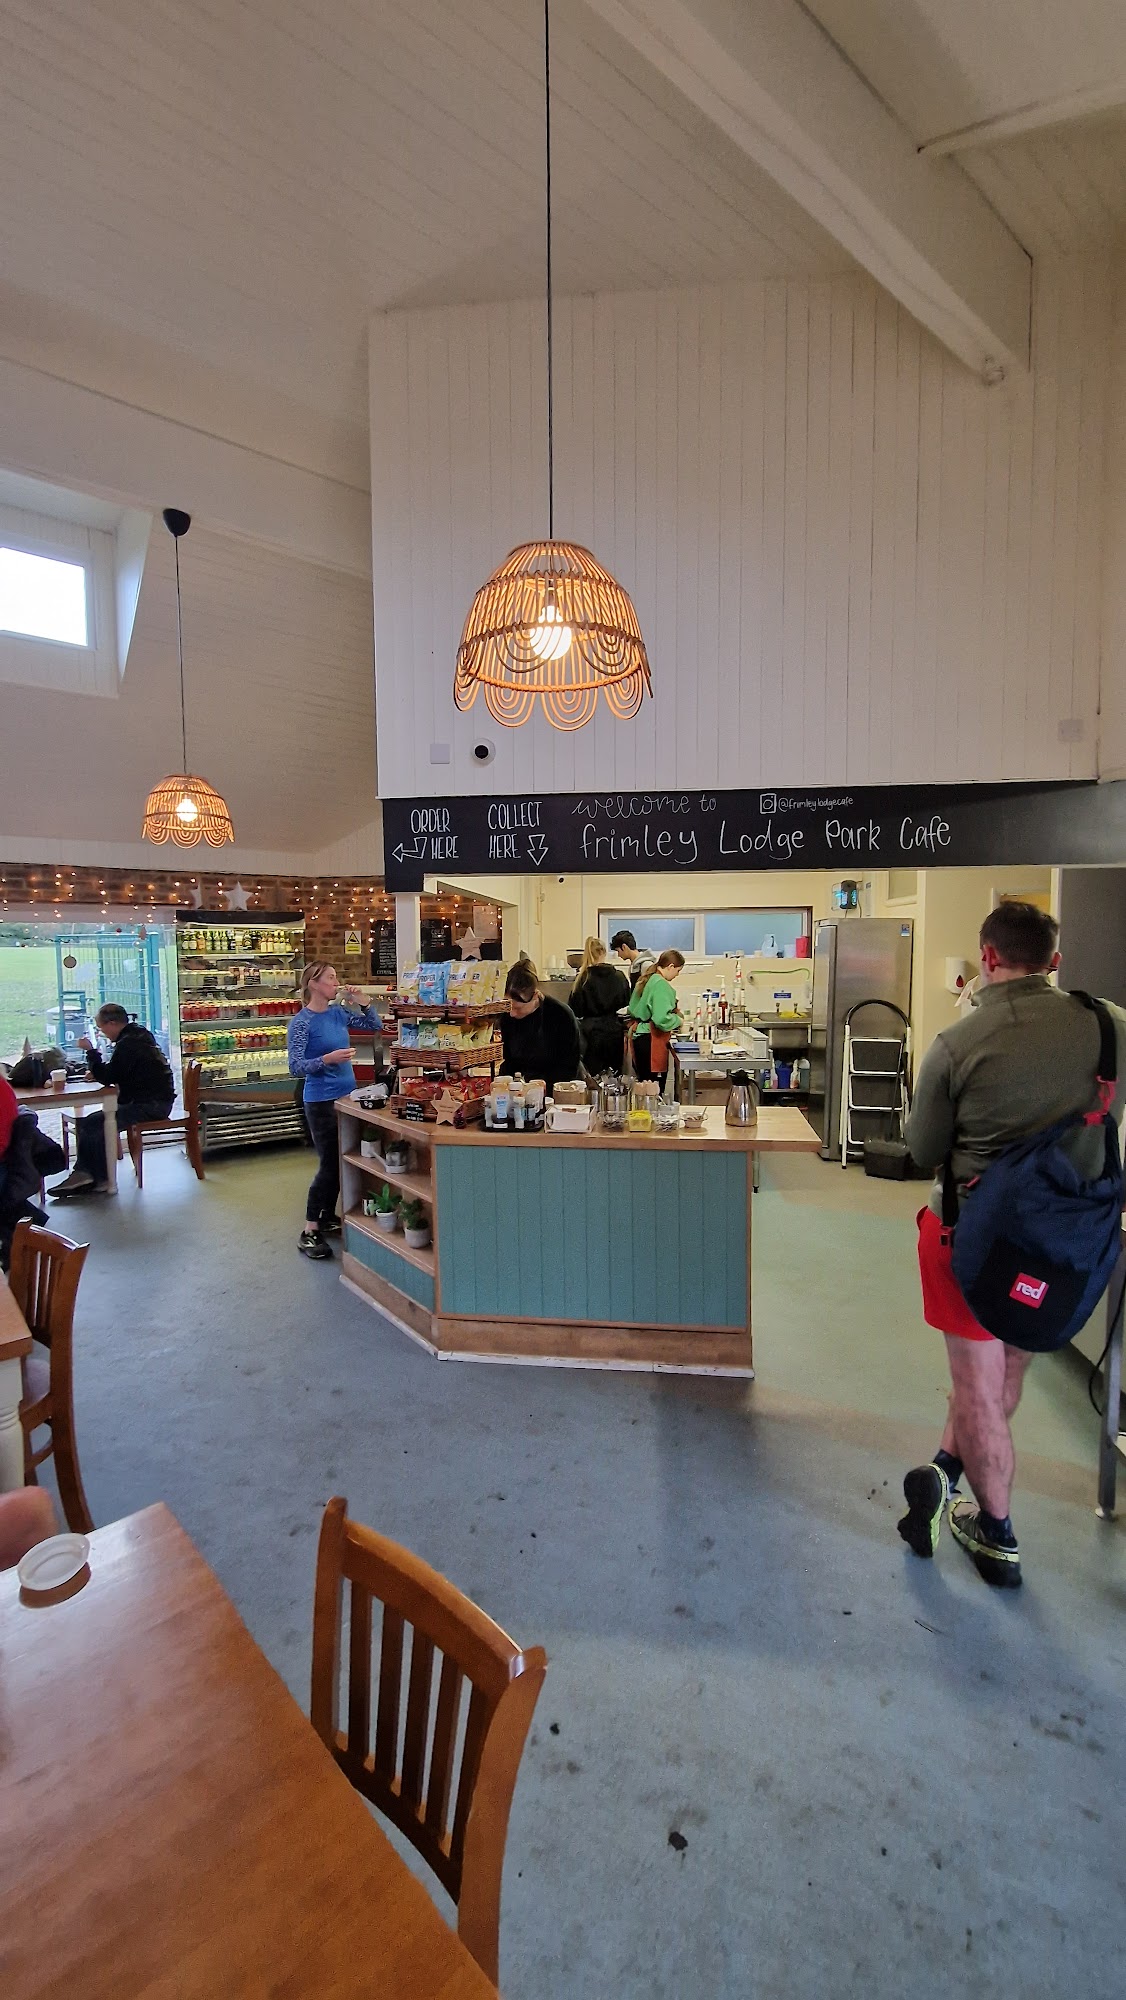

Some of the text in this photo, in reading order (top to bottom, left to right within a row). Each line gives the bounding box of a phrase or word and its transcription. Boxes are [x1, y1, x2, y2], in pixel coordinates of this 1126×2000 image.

[487, 801, 543, 830] COLLECT
[571, 794, 717, 818] welcome to
[410, 808, 451, 834] ORDER
[431, 835, 460, 860] HERE
[488, 833, 522, 860] HERE
[719, 819, 805, 860] Lodge
[825, 819, 881, 851] Park
[900, 815, 951, 853] Cafe
[1015, 1281, 1046, 1300] red
